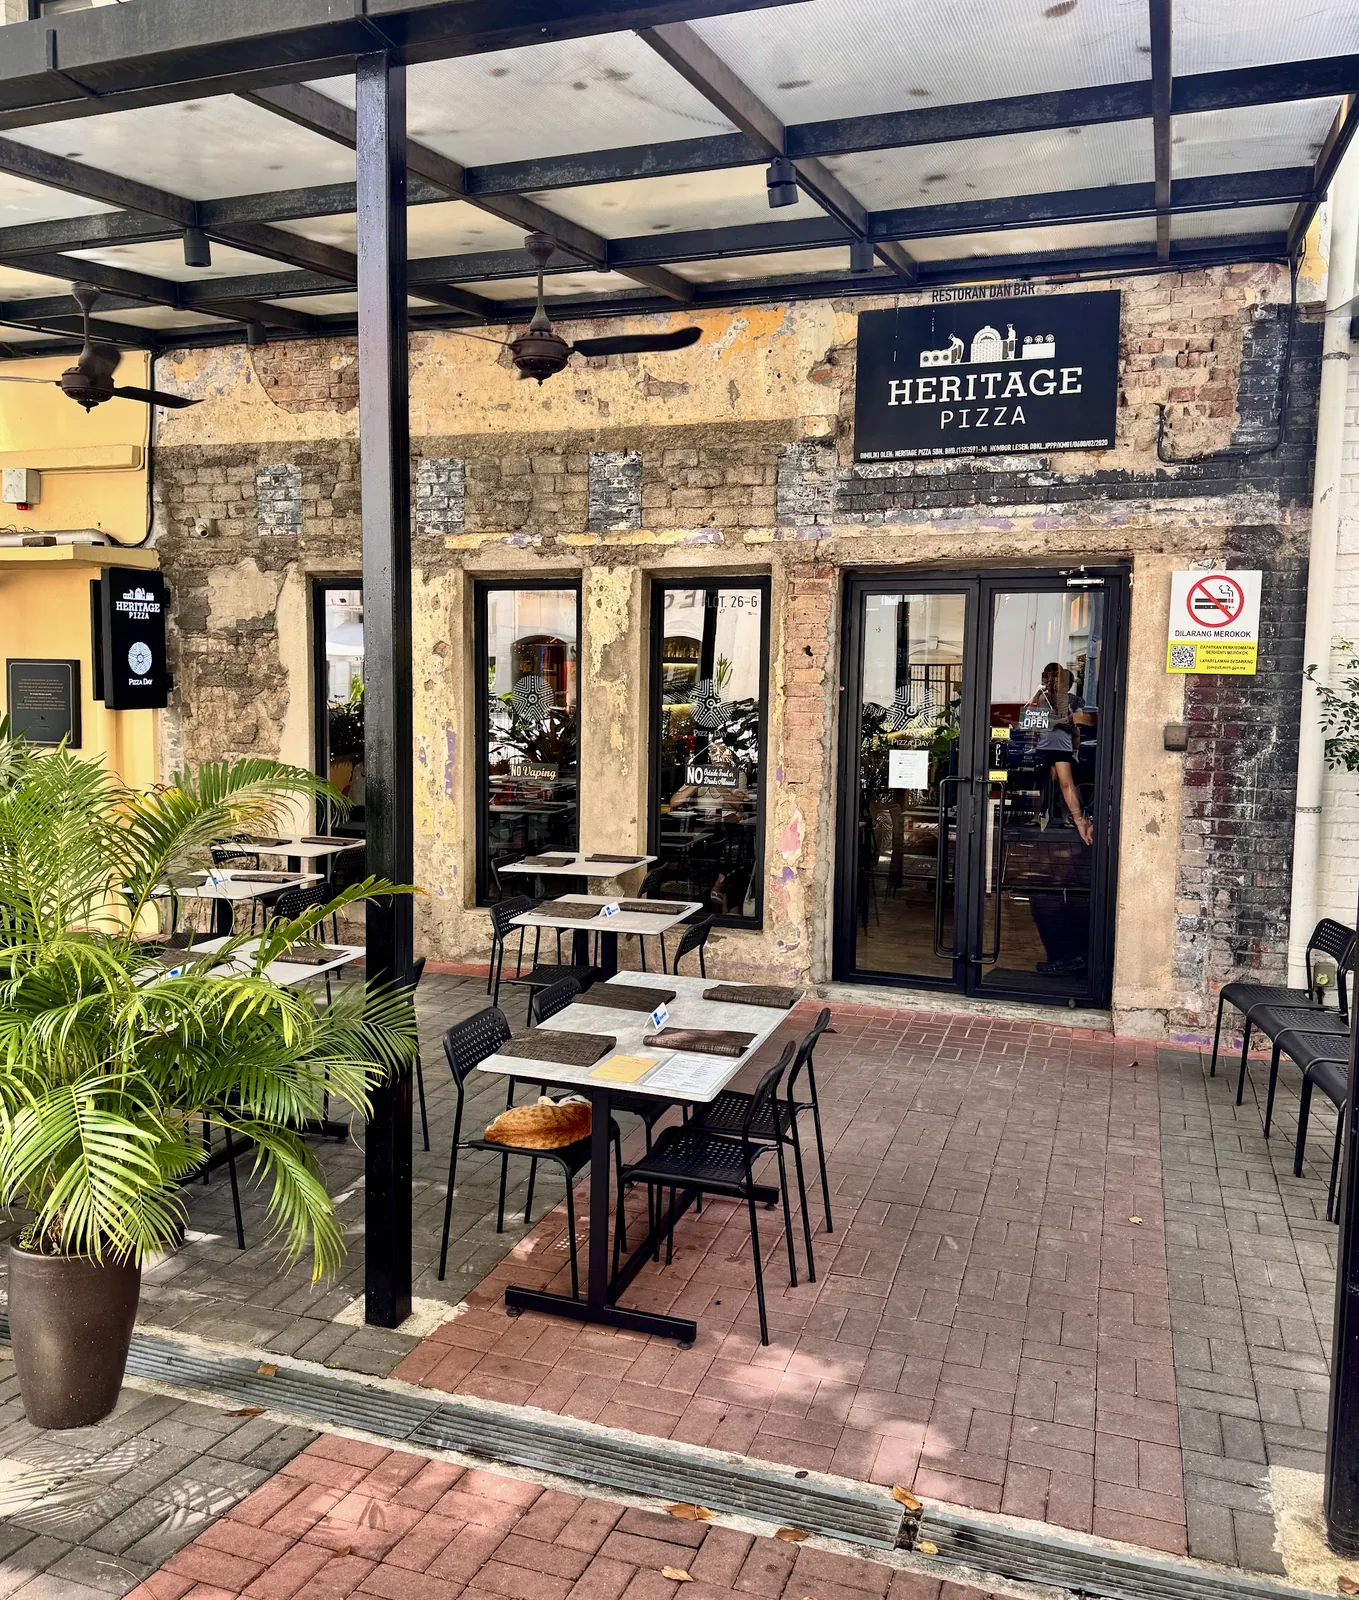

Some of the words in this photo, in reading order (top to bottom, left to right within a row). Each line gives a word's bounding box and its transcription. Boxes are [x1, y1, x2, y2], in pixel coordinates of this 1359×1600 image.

[932, 288, 987, 303] RESTORAN
[989, 286, 1011, 300] DAN
[1014, 282, 1036, 297] BAR
[888, 367, 1082, 406] HERITAGE
[940, 405, 1026, 429] PIZZA
[894, 448, 918, 457] HERITAGE
[918, 448, 931, 456] PIZZA
[116, 601, 160, 613] HERITAGE
[707, 595, 727, 608] LOT.
[730, 595, 758, 608] 26-G
[128, 611, 150, 619] PIZZA
[1023, 718, 1049, 729] OPEN
[510, 765, 522, 776] NO
[522, 765, 557, 780] Vaping
[687, 766, 704, 784] NO
